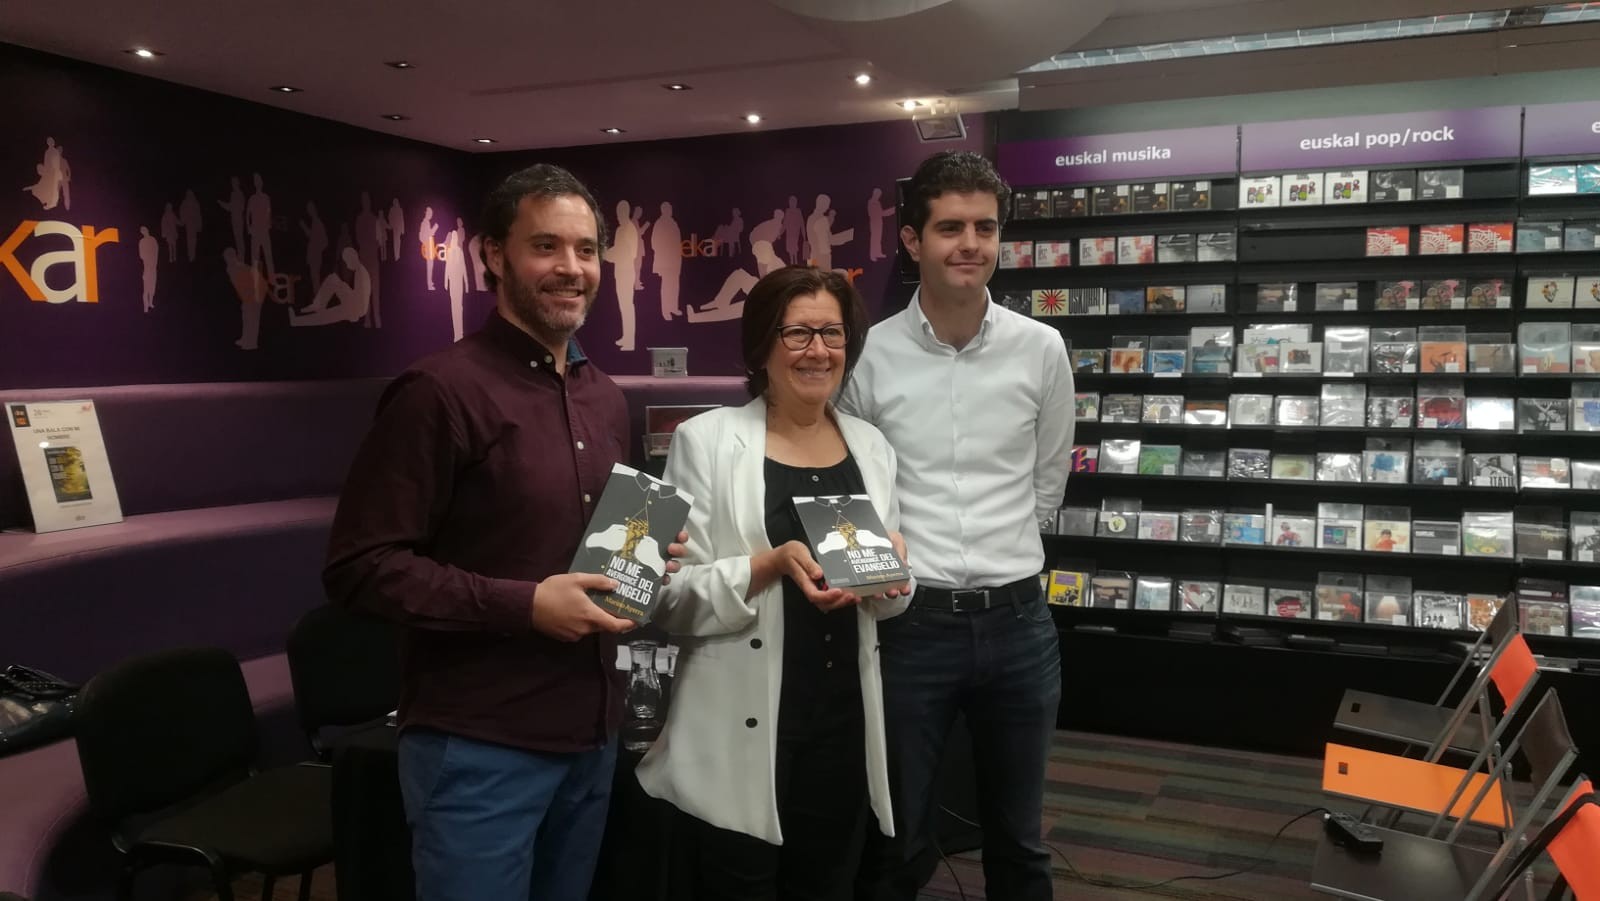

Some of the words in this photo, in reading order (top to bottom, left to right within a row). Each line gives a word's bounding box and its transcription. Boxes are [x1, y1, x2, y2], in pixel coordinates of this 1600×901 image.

[1300, 132, 1360, 150] euskal
[1366, 126, 1455, 149] pop/rock
[1055, 149, 1108, 167] euskal
[1112, 146, 1172, 162] musika
[847, 549, 862, 559] NO
[861, 547, 878, 558] ME
[879, 552, 897, 561] DEL
[610, 555, 626, 571] NO
[625, 561, 643, 578] ME
[853, 560, 900, 574] EVANGELIO
[614, 582, 652, 606] ANGELIO
[638, 577, 654, 594] DEL
